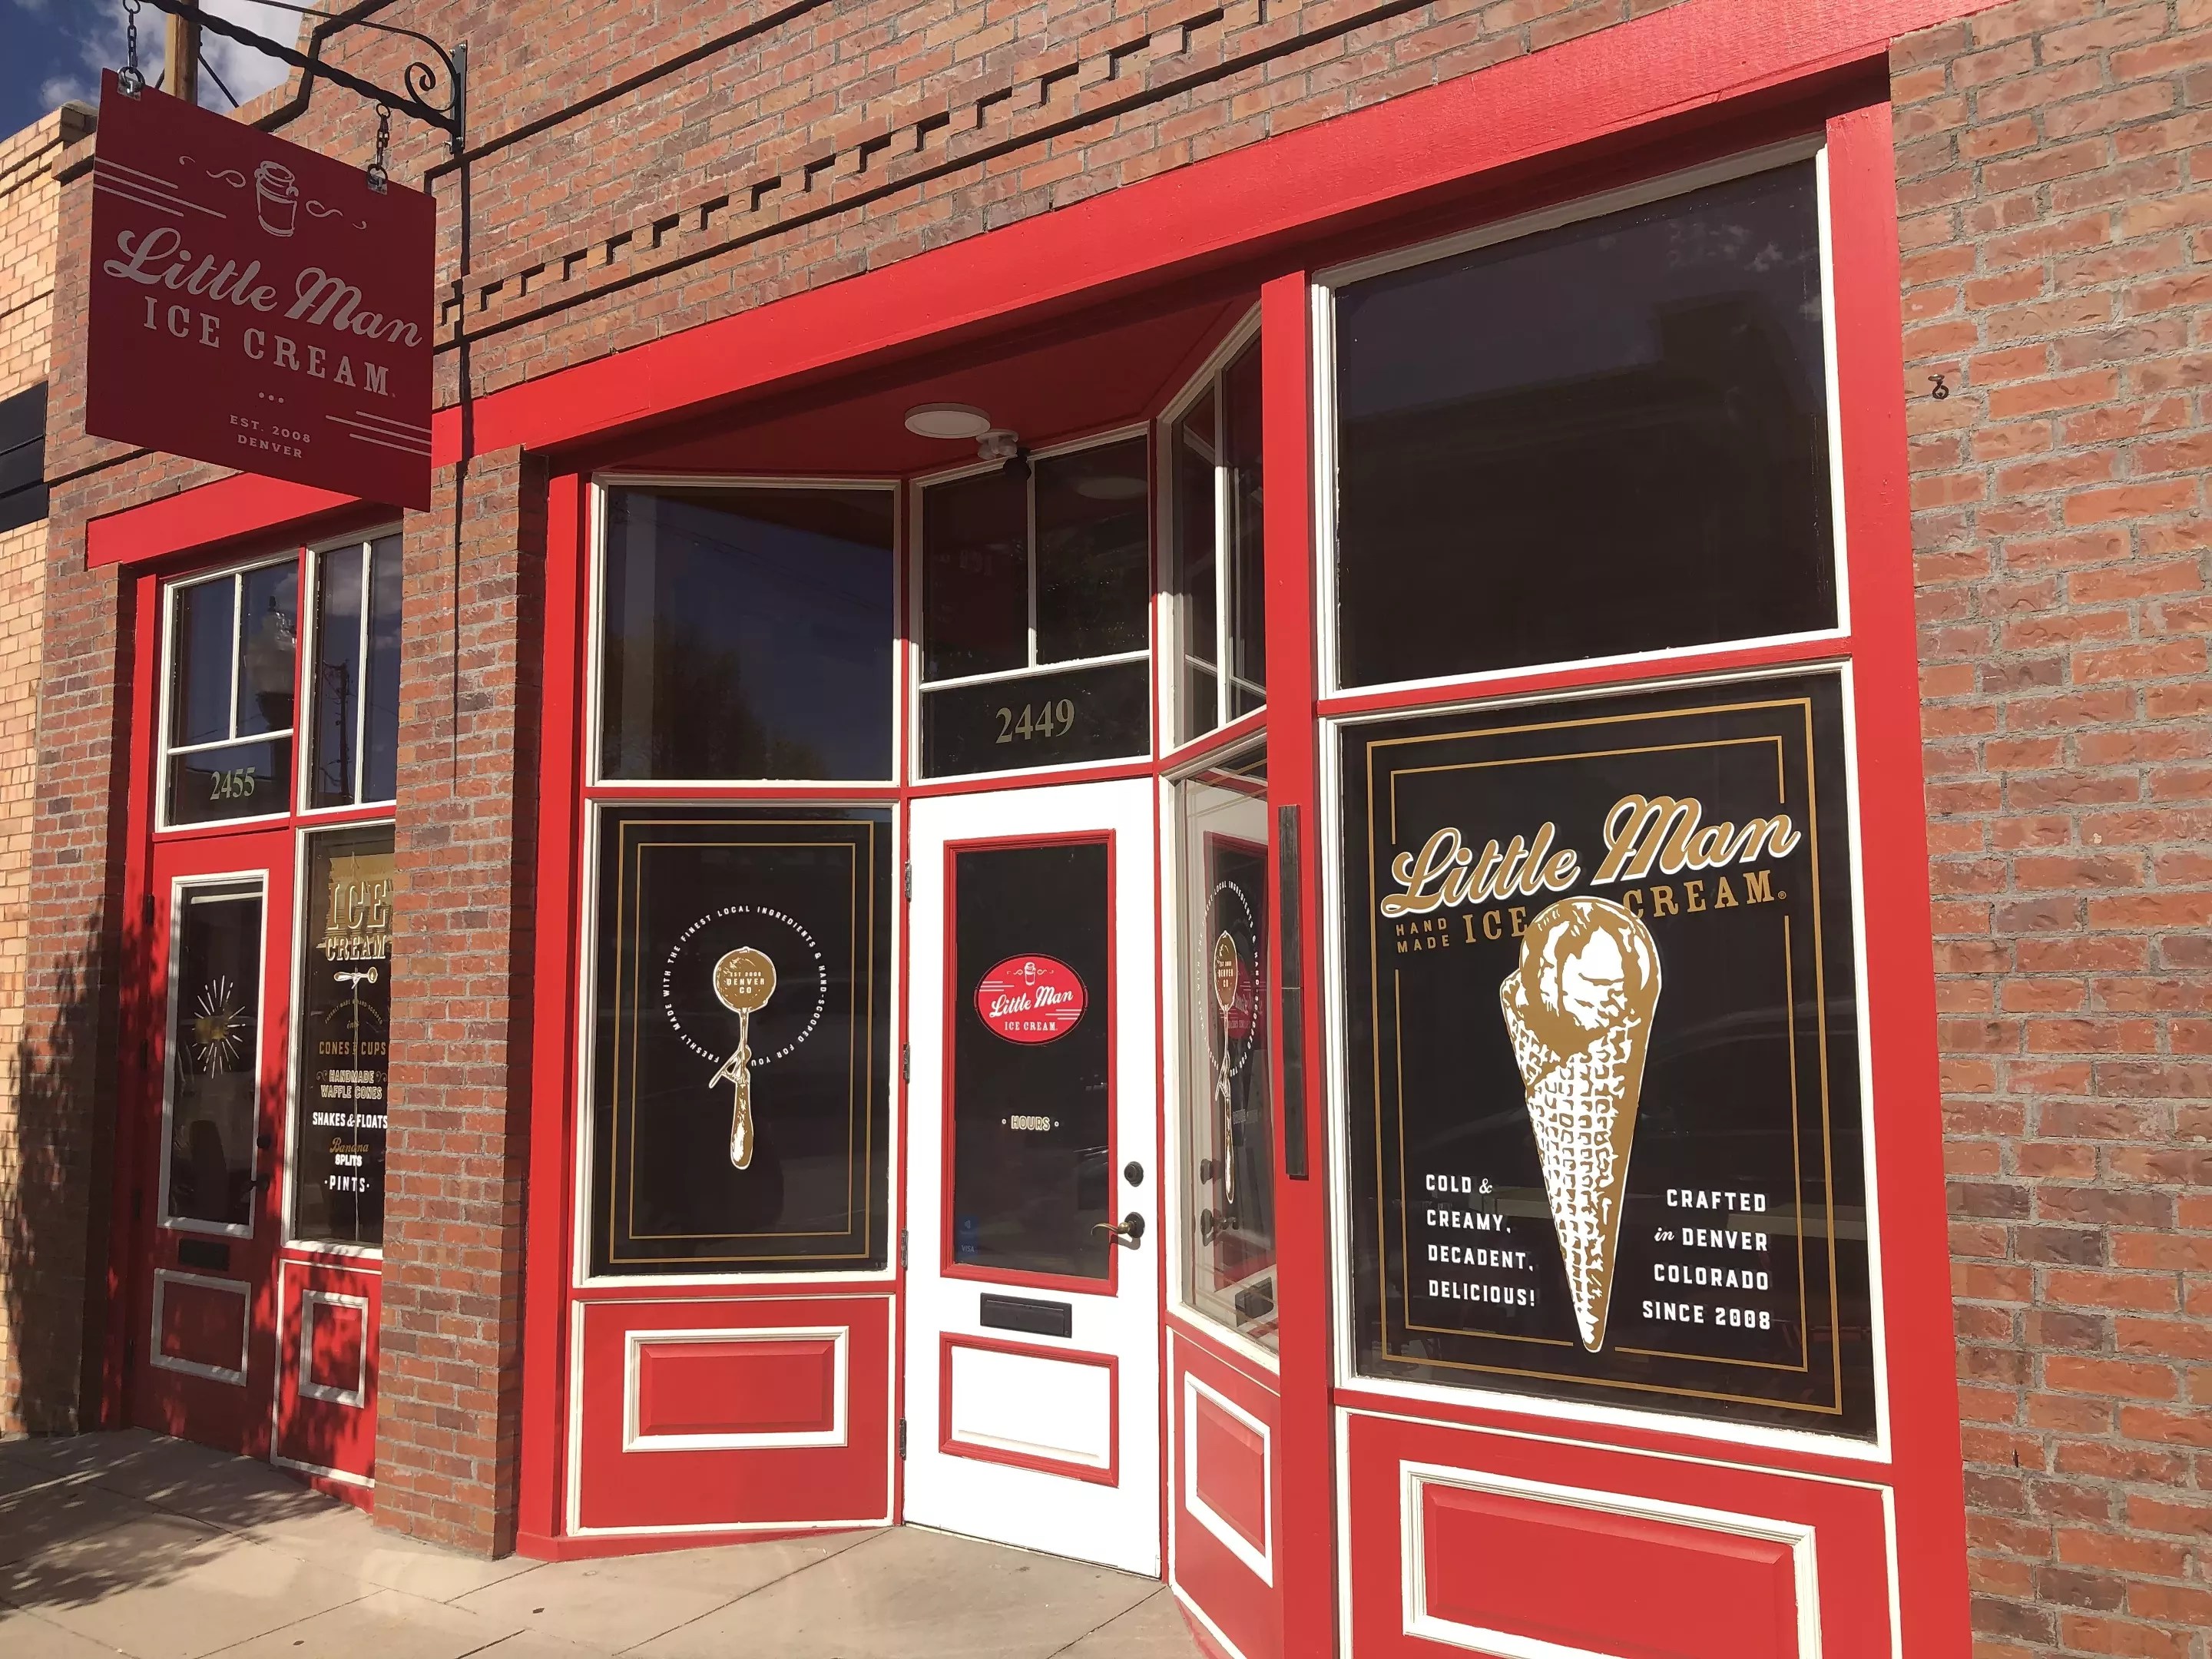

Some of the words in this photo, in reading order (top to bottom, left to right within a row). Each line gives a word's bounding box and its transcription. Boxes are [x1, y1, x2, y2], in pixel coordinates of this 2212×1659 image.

[104, 227, 278, 313] Little
[283, 267, 423, 347] Man
[144, 295, 220, 349] ICE
[230, 414, 265, 433] EST.
[272, 425, 312, 443] 2008
[237, 434, 303, 459] DENVER
[995, 697, 1075, 745] 2449
[209, 767, 256, 800] 2455
[1380, 821, 1582, 918] Little
[1591, 793, 1801, 886] Man
[328, 879, 387, 930] ICE
[717, 905, 750, 917] LOCAL
[680, 914, 712, 942] FINEST
[757, 906, 816, 949] INGREDIENTS
[1396, 917, 1448, 936] HAND
[1463, 905, 1529, 943] ICE
[326, 934, 386, 961] CREAM
[667, 945, 681, 964] THE
[1396, 935, 1451, 954] MADE
[663, 970, 672, 997] WITH
[726, 978, 766, 986] DENVER
[797, 965, 827, 1043] HAND-SCOOPED
[988, 992, 1032, 1018] Little
[1034, 985, 1074, 1008] Man
[664, 1003, 681, 1031] MADE
[1005, 1022, 1021, 1031] ICE
[319, 1041, 349, 1055] CONES
[361, 1041, 386, 1055] CUPS
[680, 1034, 720, 1064] FRESHLY
[776, 1044, 795, 1058] FOR
[751, 1056, 771, 1067] YOU
[329, 1069, 375, 1084] HANDMADE
[320, 1084, 352, 1099] WAFFLE
[354, 1085, 382, 1100] CONES
[313, 1111, 346, 1127] SHAKES
[346, 1113, 355, 1128] &
[356, 1114, 388, 1129] FLOATS
[1011, 1115, 1051, 1131] HOURS
[329, 1137, 369, 1154] Banana
[335, 1154, 363, 1167] SPLITS
[1426, 1174, 1472, 1194] COLD
[1479, 1177, 1492, 1194] &
[1666, 1188, 1767, 1214] CRAFTED
[1426, 1209, 1512, 1234] CREAMY,
[962, 1244, 975, 1253] VISA
[1654, 1227, 1675, 1243] in
[1682, 1227, 1768, 1252] DENVER
[1428, 1244, 1535, 1272] DECADENT,
[1654, 1263, 1769, 1291] COLORADO
[1429, 1279, 1535, 1307] DELICIOUS!
[1642, 1300, 1704, 1324] SINCE
[1714, 1306, 1771, 1330] 2008
